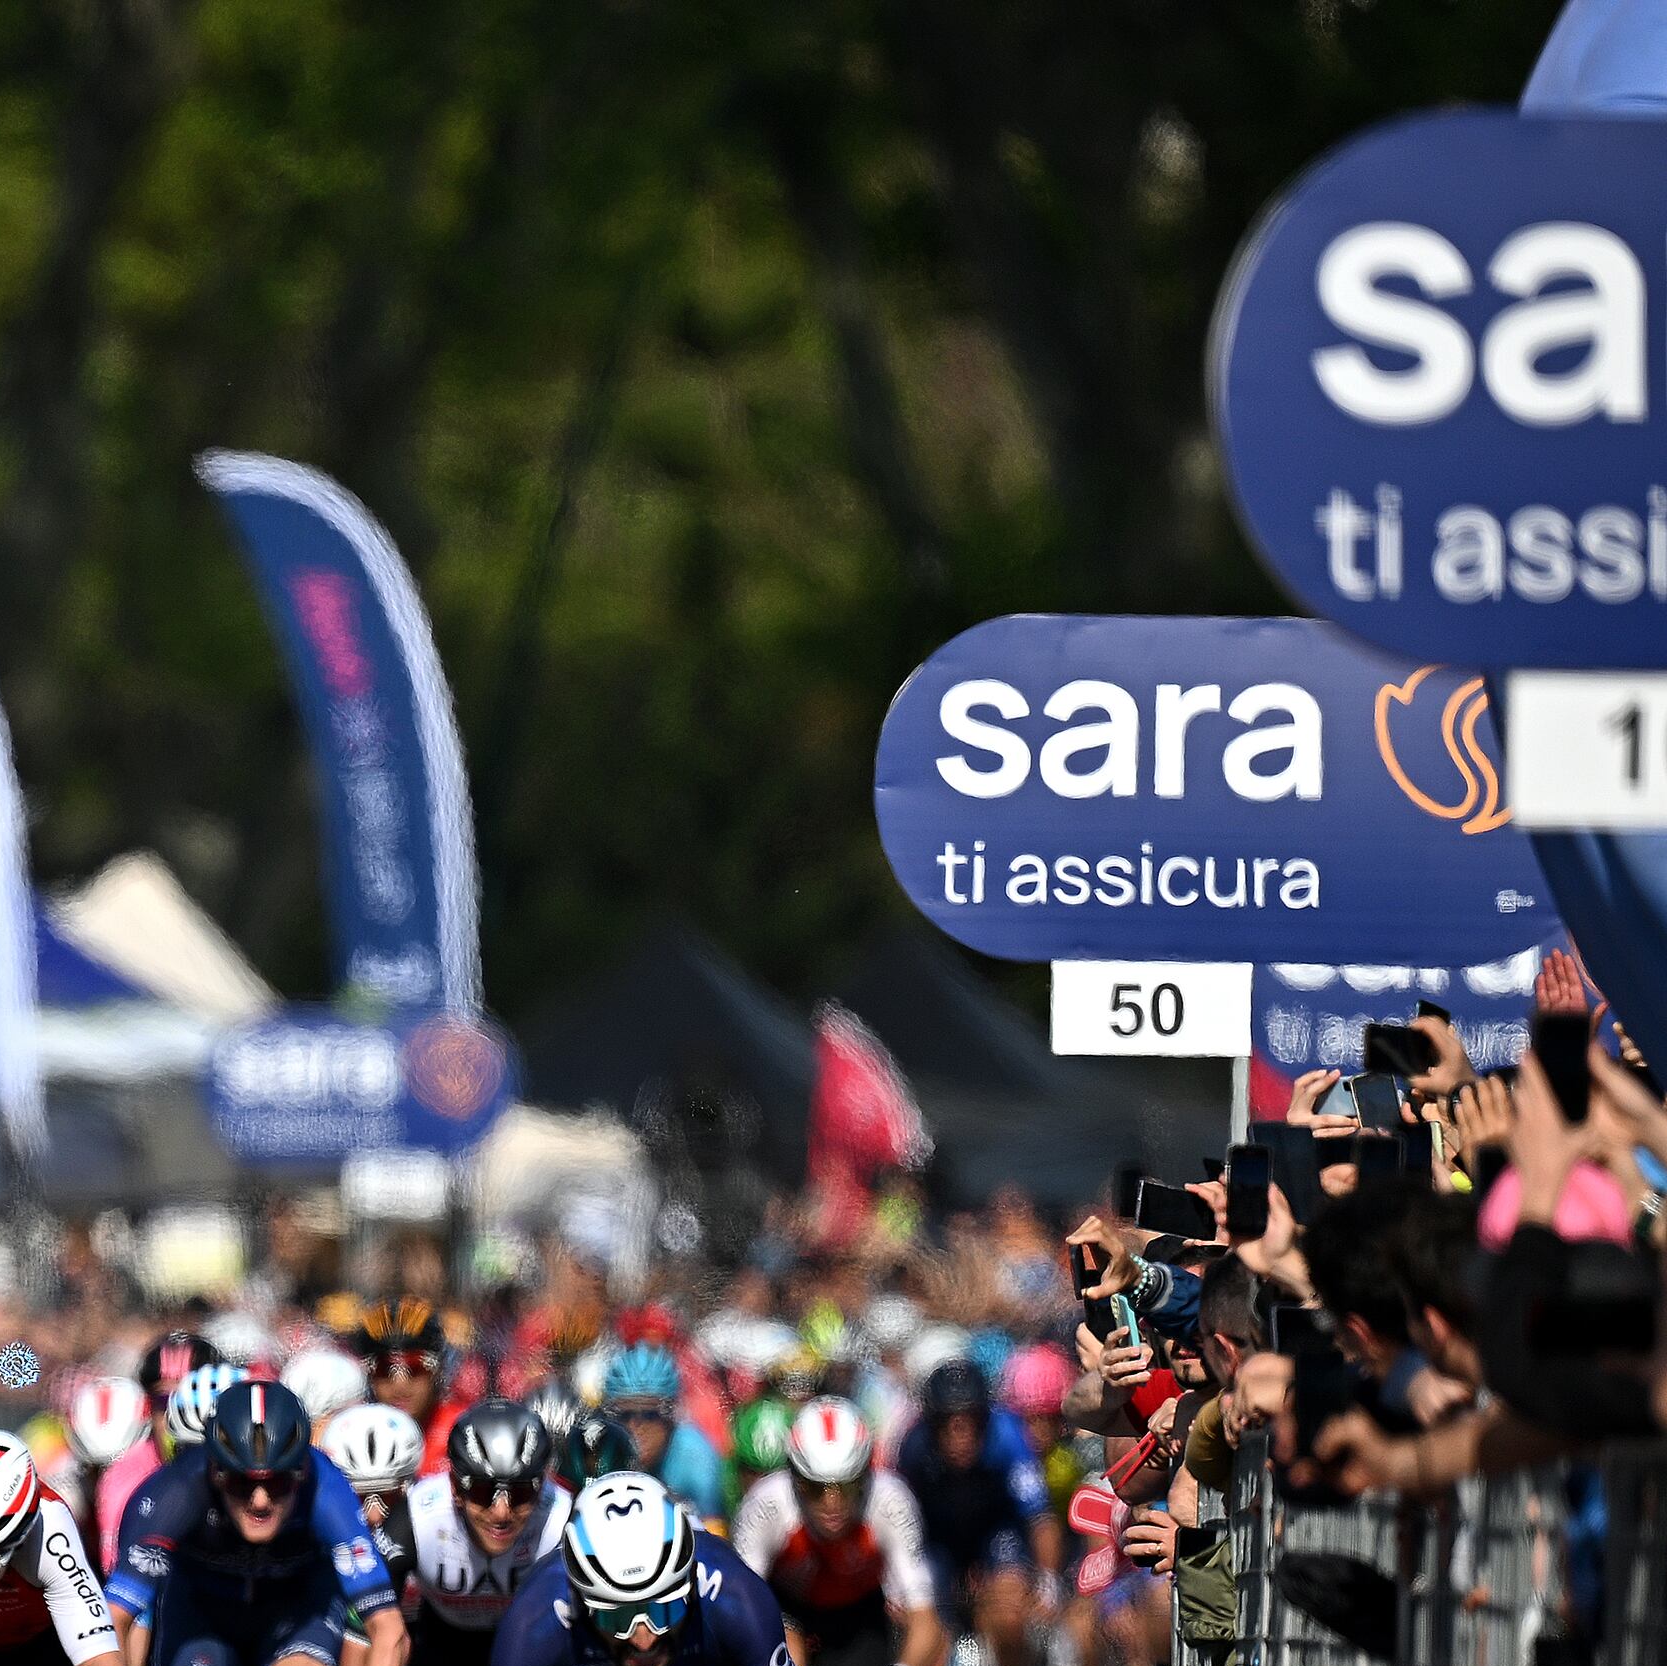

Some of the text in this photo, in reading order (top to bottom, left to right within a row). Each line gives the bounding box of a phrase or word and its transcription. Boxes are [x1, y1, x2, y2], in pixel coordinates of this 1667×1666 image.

[934, 678, 1325, 802] sara
[936, 838, 1322, 908] ti assicura
[1110, 982, 1185, 1038] 50
[45, 1532, 105, 1618] Cofidis
